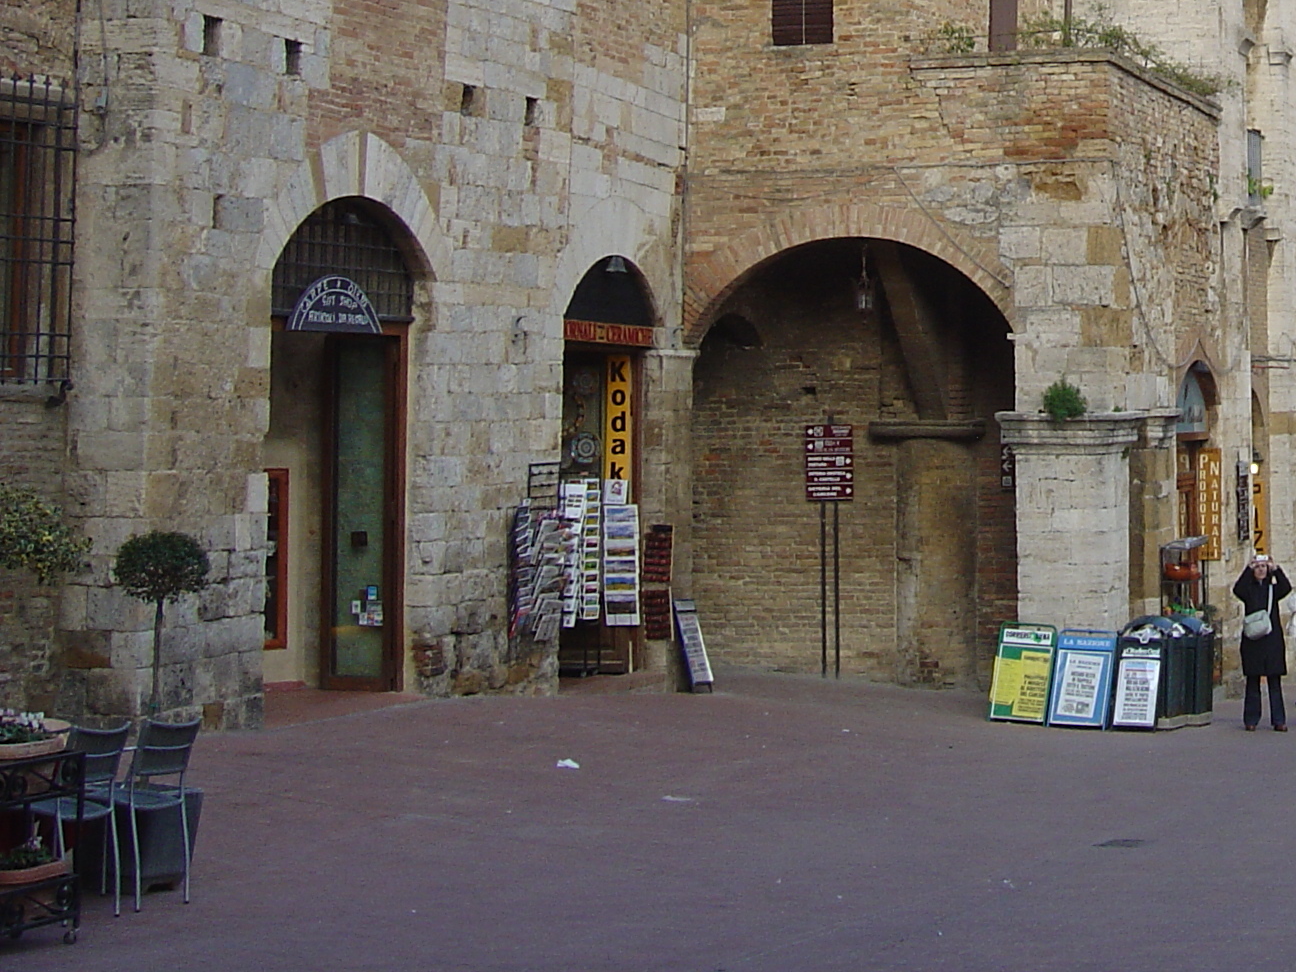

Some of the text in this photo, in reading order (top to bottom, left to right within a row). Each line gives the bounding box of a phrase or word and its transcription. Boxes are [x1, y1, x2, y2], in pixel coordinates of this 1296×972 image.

[566, 320, 596, 341] ORNALI
[609, 360, 627, 480] Kodak
[1199, 453, 1209, 548] PRODOTT
[1210, 460, 1220, 559] NATURALI
[1063, 638, 1112, 647] LA NAZIONE
